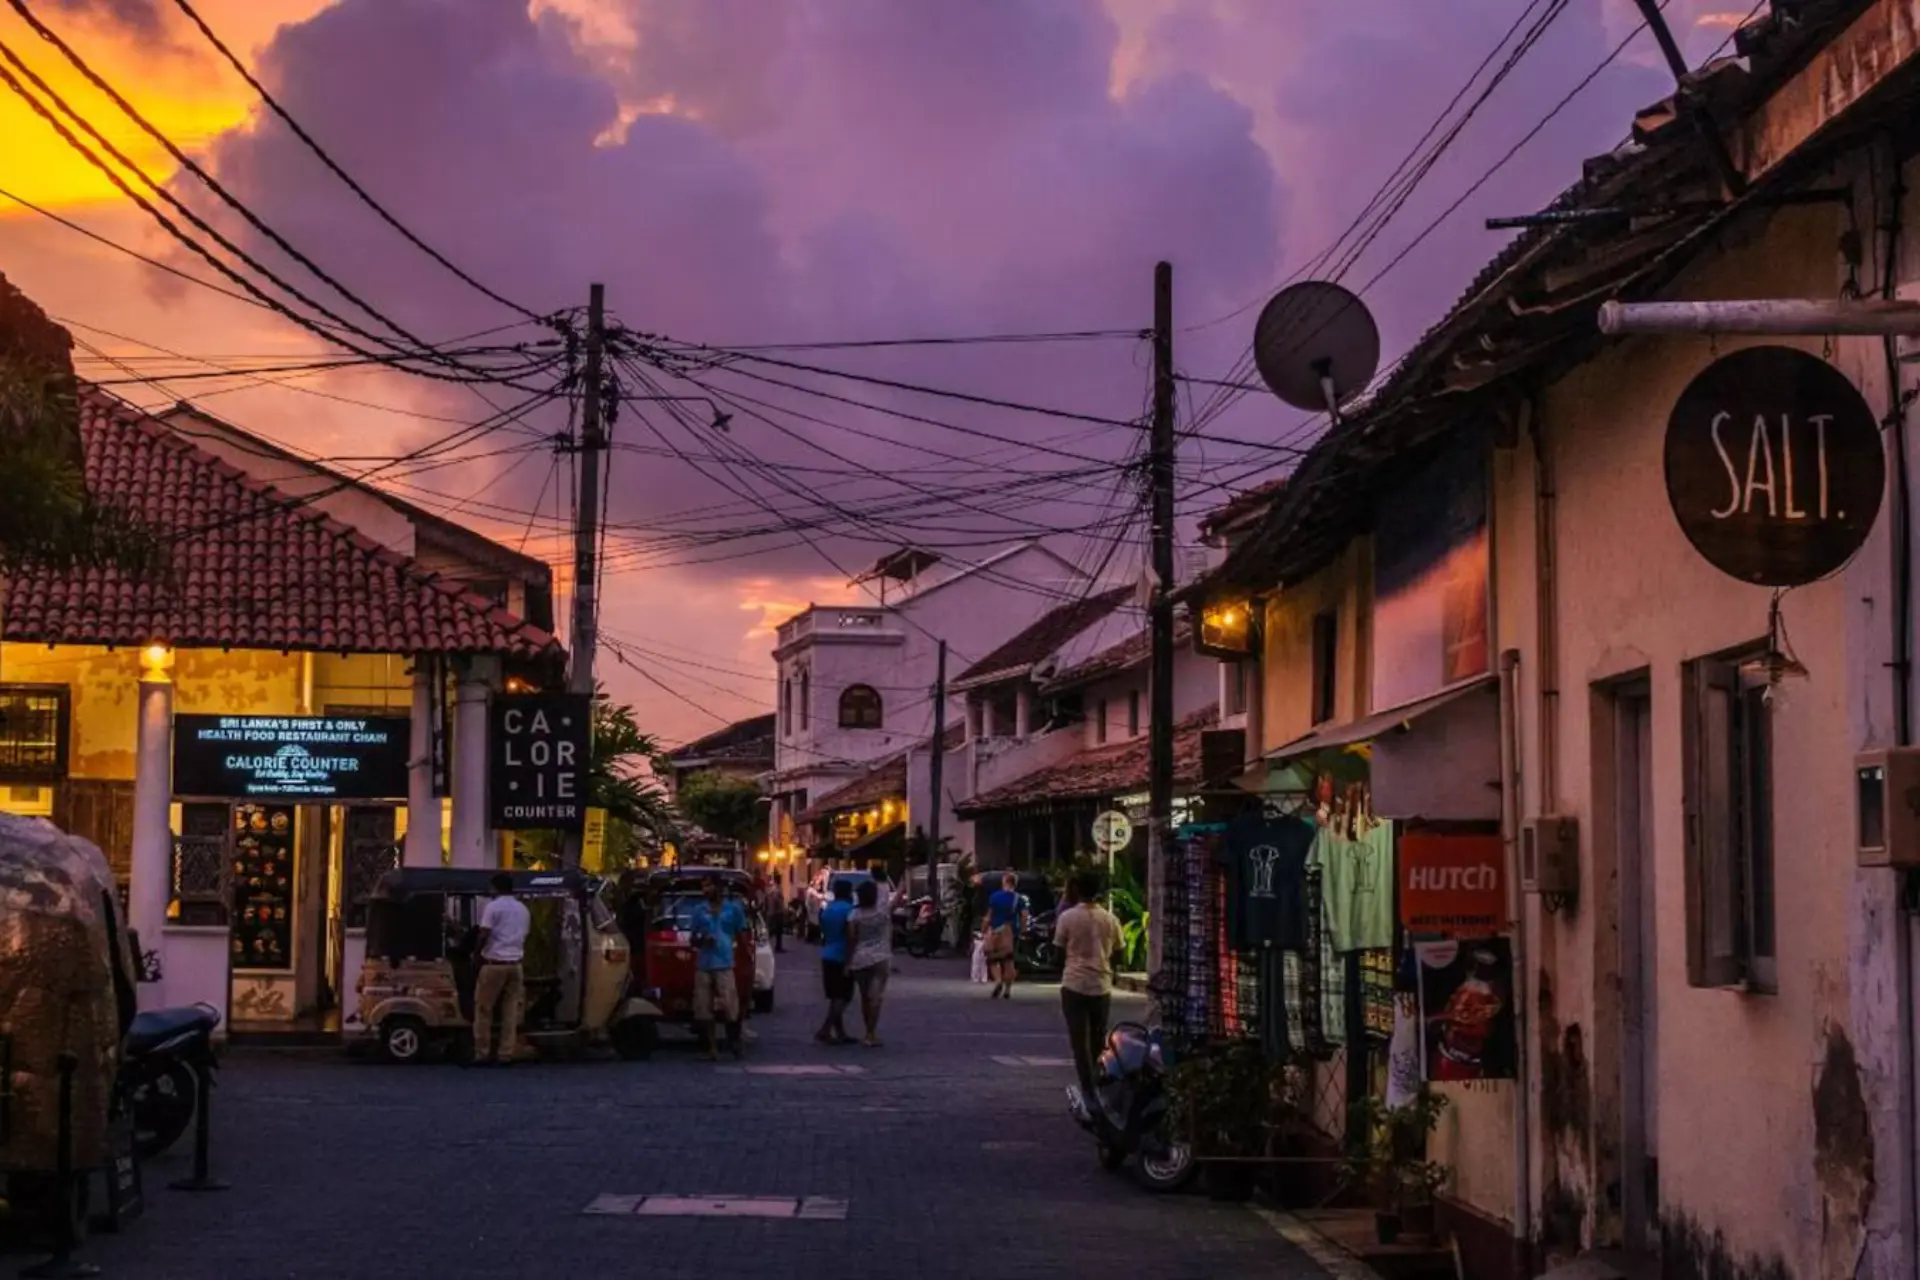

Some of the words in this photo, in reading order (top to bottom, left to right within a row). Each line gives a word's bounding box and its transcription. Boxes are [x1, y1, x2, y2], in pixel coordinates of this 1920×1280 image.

[1710, 410, 1845, 519] SALT.
[219, 718, 240, 729] SRI
[241, 718, 290, 730] LANKA'S
[291, 719, 323, 731] FIRST
[325, 720, 334, 731] &
[335, 720, 367, 731] ONLY
[198, 729, 242, 740] HEALTH
[244, 730, 276, 741] FOOD
[278, 730, 351, 743] RESTAURANT
[353, 732, 387, 743] CHAIN
[226, 756, 288, 769] CALORIE
[290, 756, 359, 771] COUNTER
[504, 805, 576, 818] COUNTER
